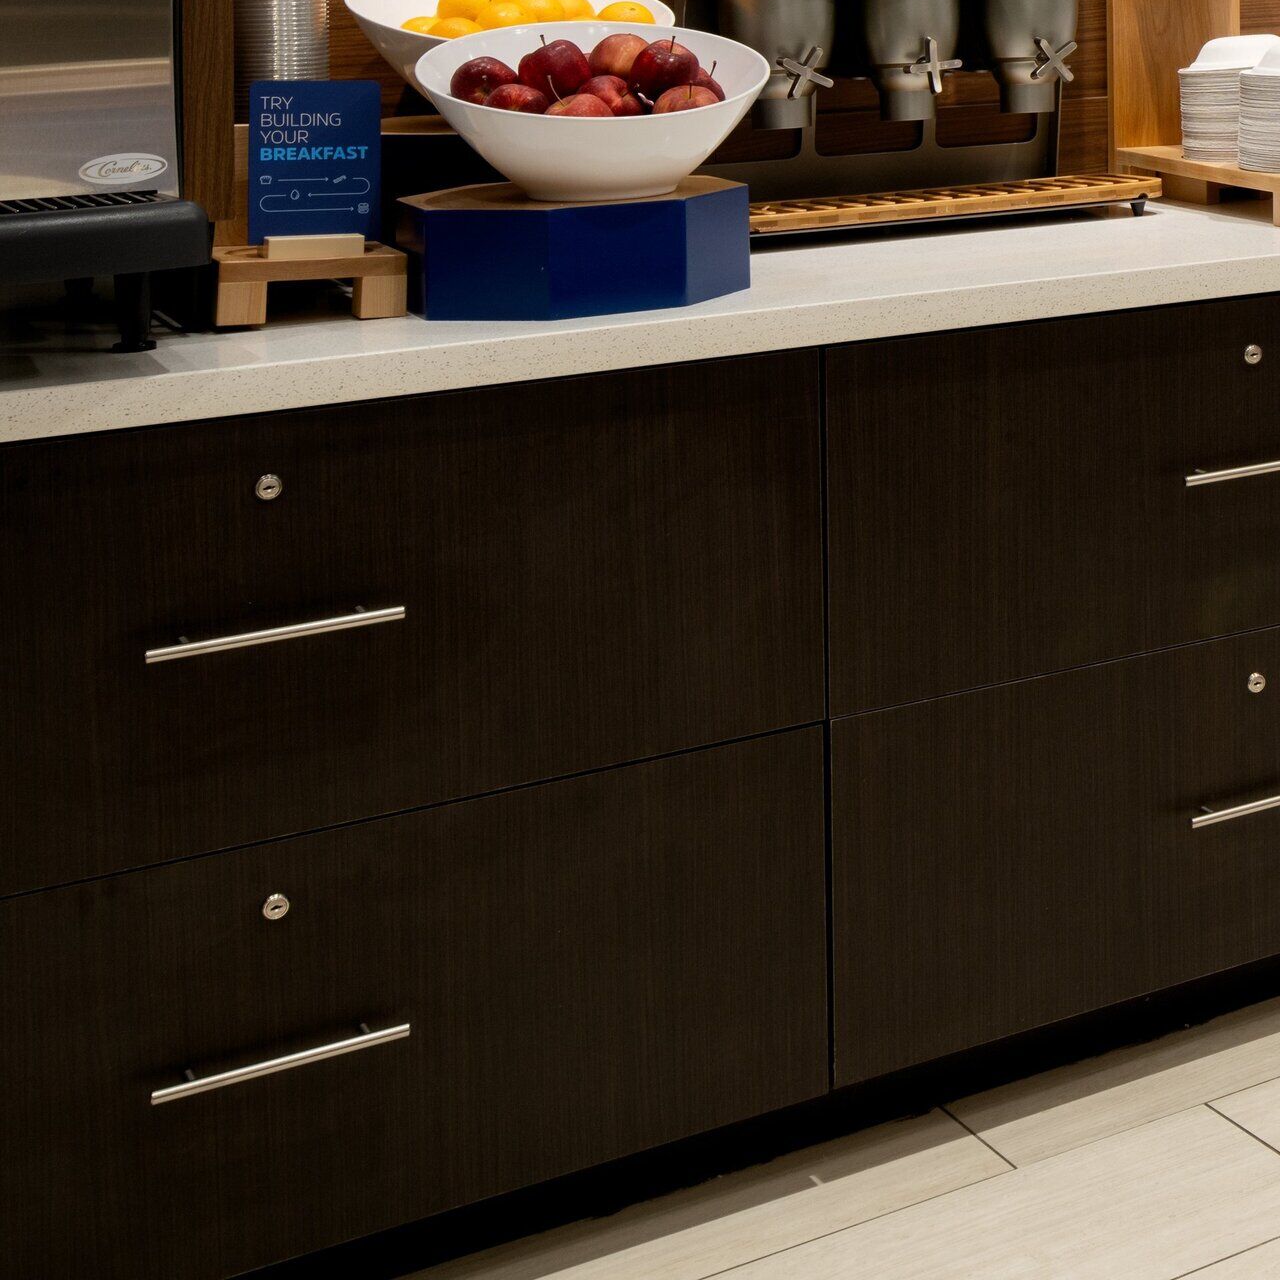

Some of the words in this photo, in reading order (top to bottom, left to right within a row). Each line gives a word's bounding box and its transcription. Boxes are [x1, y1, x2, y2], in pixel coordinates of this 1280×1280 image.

[260, 96, 293, 110] TRY
[260, 112, 342, 128] BUILDING
[260, 130, 309, 144] YOUR
[260, 146, 369, 161] BREAKFAST
